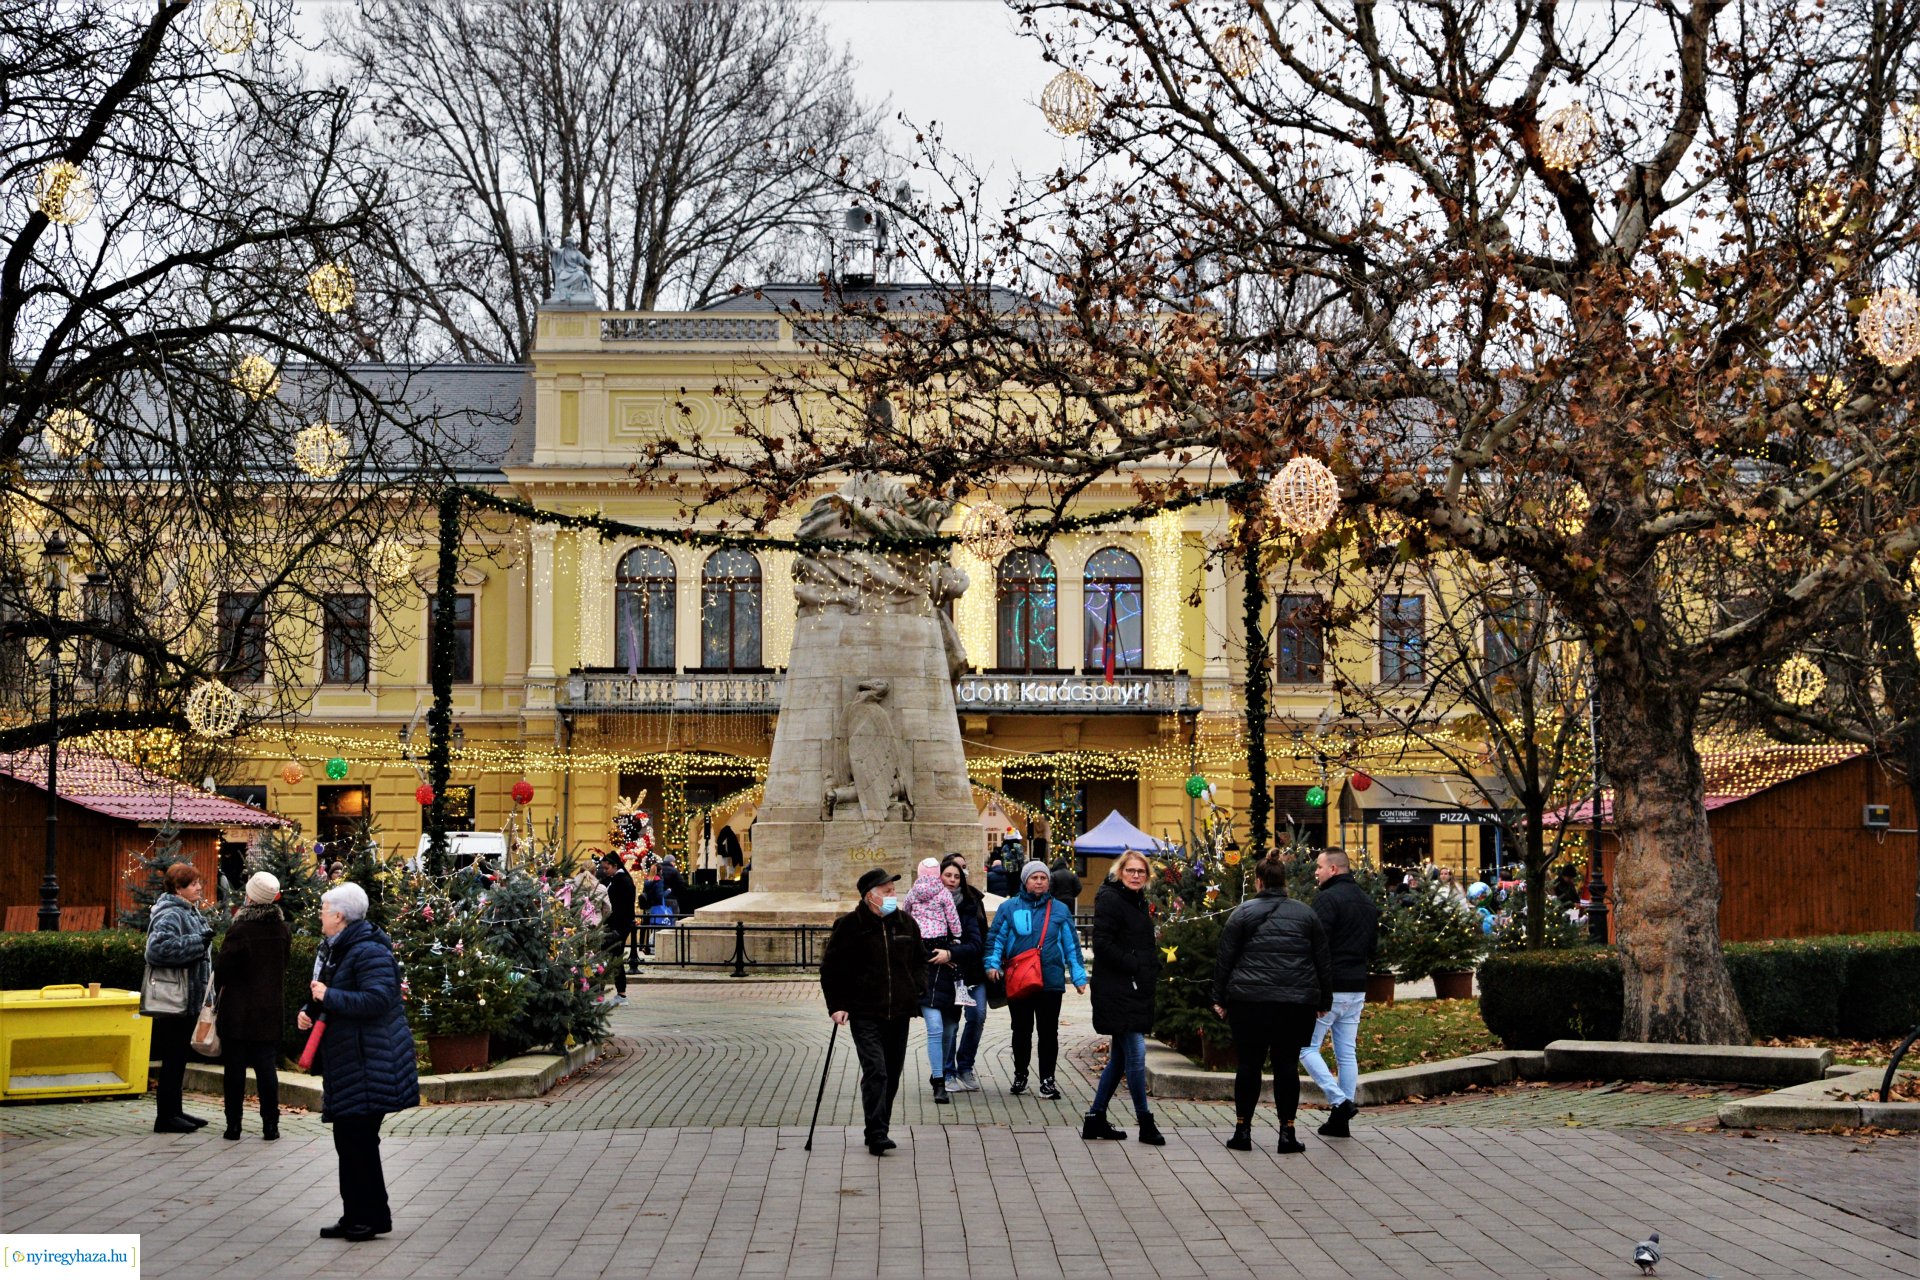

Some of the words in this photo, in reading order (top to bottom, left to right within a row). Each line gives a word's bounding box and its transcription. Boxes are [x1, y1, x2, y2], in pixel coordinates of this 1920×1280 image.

[1021, 679, 1149, 705] Karácsonyt!
[1440, 813, 1470, 822] PIZZA
[848, 847, 886, 861] 1848
